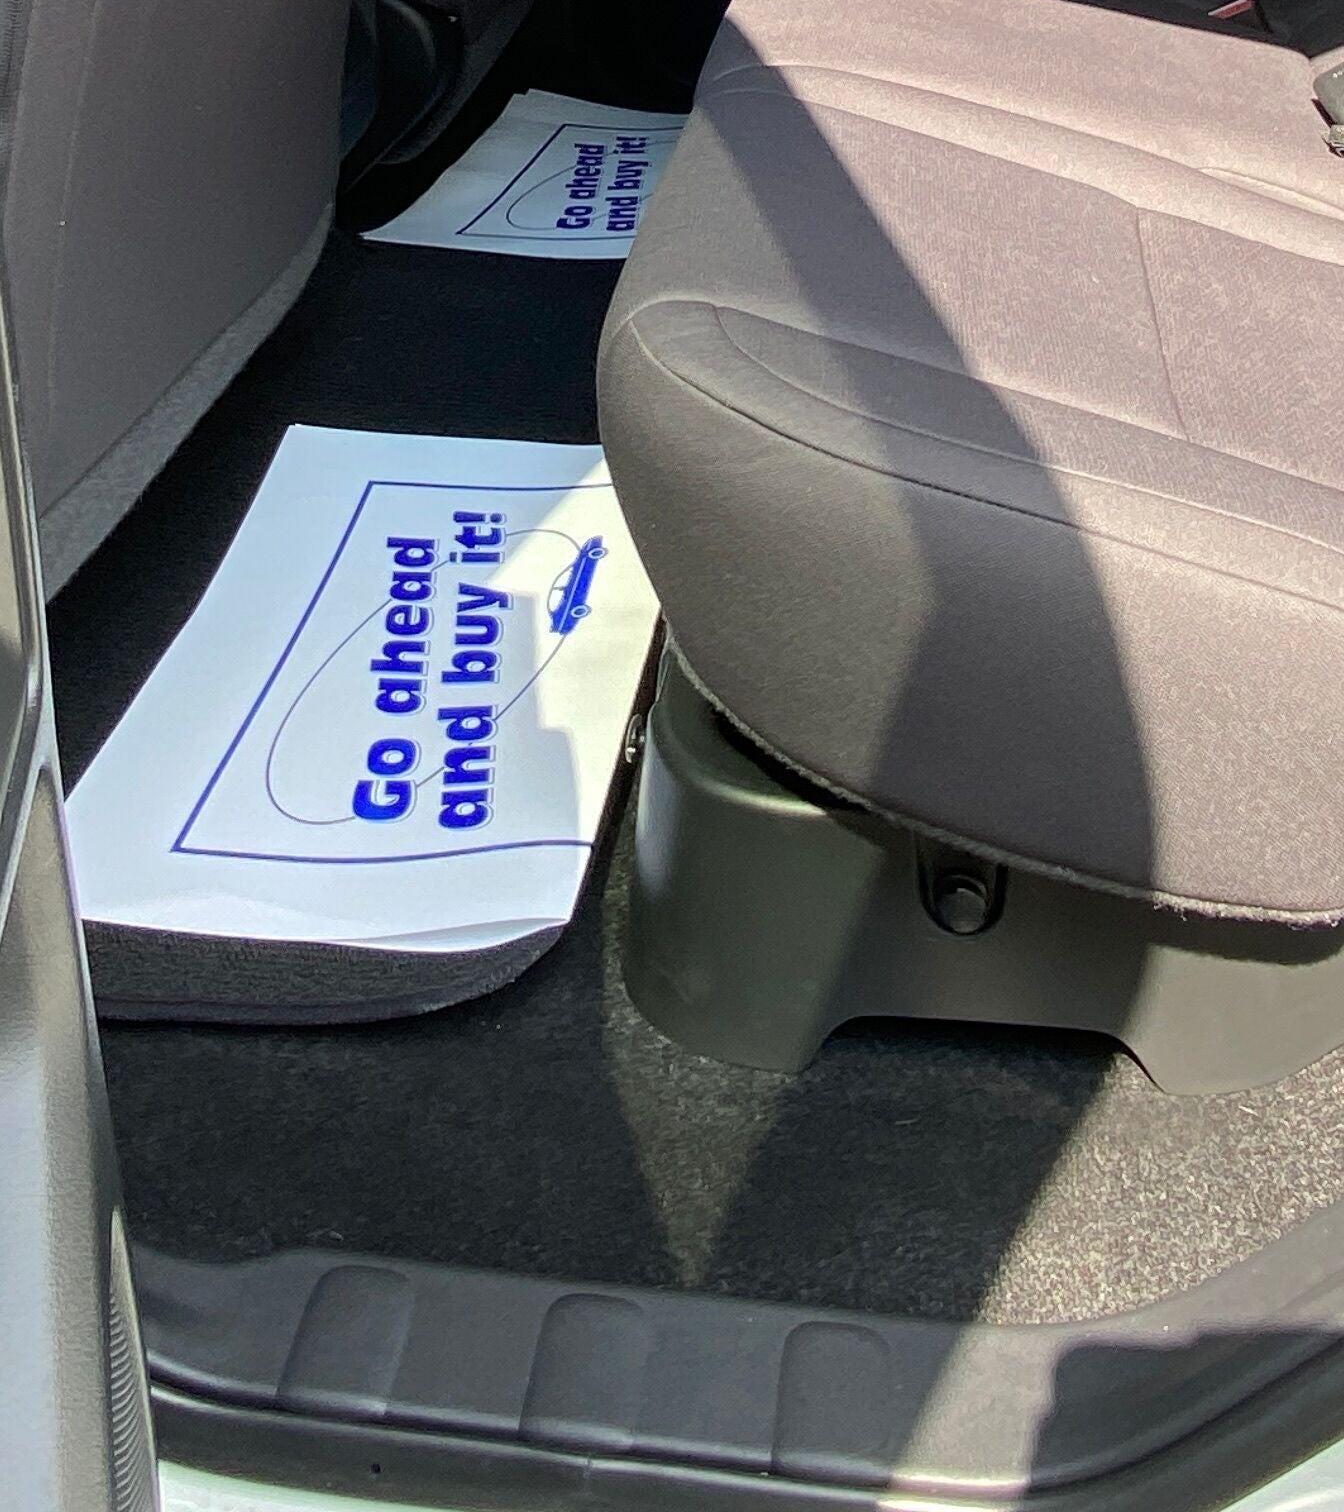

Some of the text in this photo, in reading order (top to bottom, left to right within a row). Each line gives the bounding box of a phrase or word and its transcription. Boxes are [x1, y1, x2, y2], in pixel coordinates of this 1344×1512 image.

[556, 143, 606, 230] Go ahead
[605, 136, 650, 231] and buy it!
[352, 537, 439, 822] Go ahead
[438, 510, 513, 829] and buy it!
